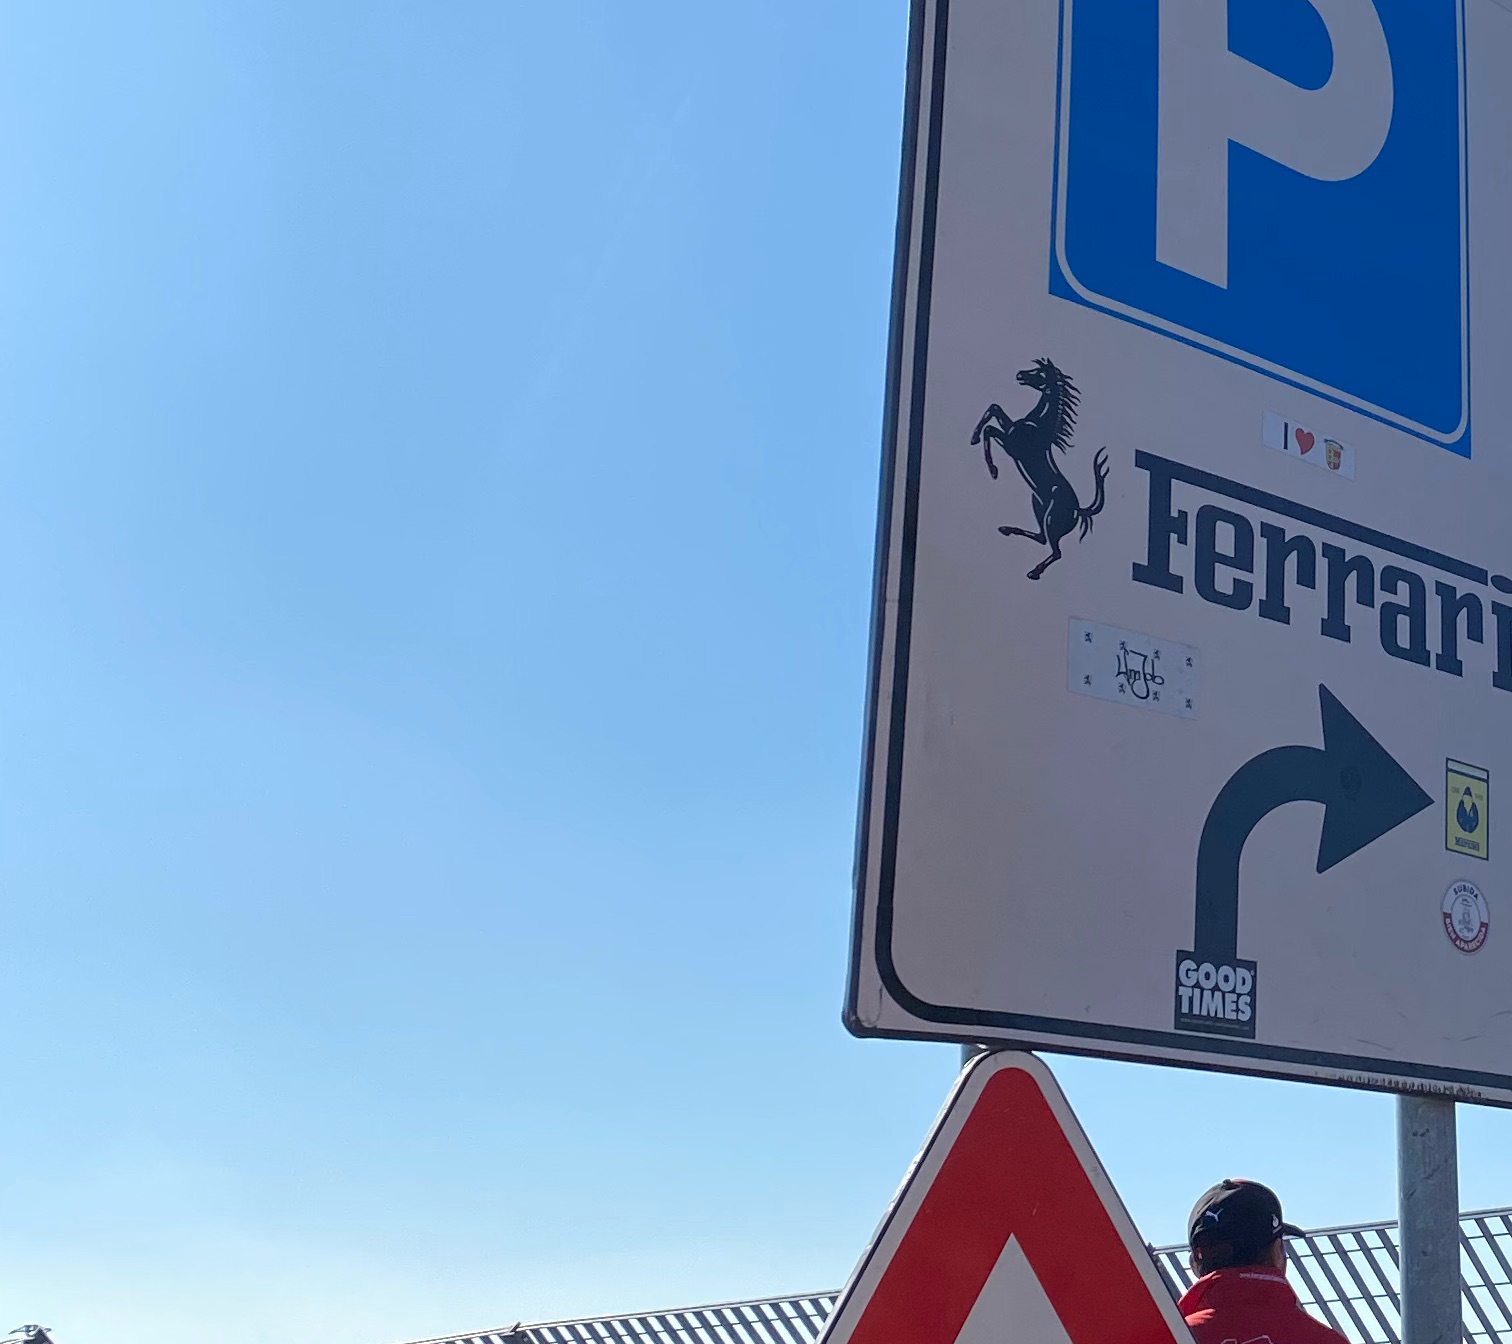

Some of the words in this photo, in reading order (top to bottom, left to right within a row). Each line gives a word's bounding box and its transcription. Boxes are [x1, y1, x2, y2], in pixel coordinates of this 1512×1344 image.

[1453, 883, 1479, 900] SUBIDA
[1178, 959, 1253, 994] GOOD
[1178, 986, 1252, 1022] TIMES
